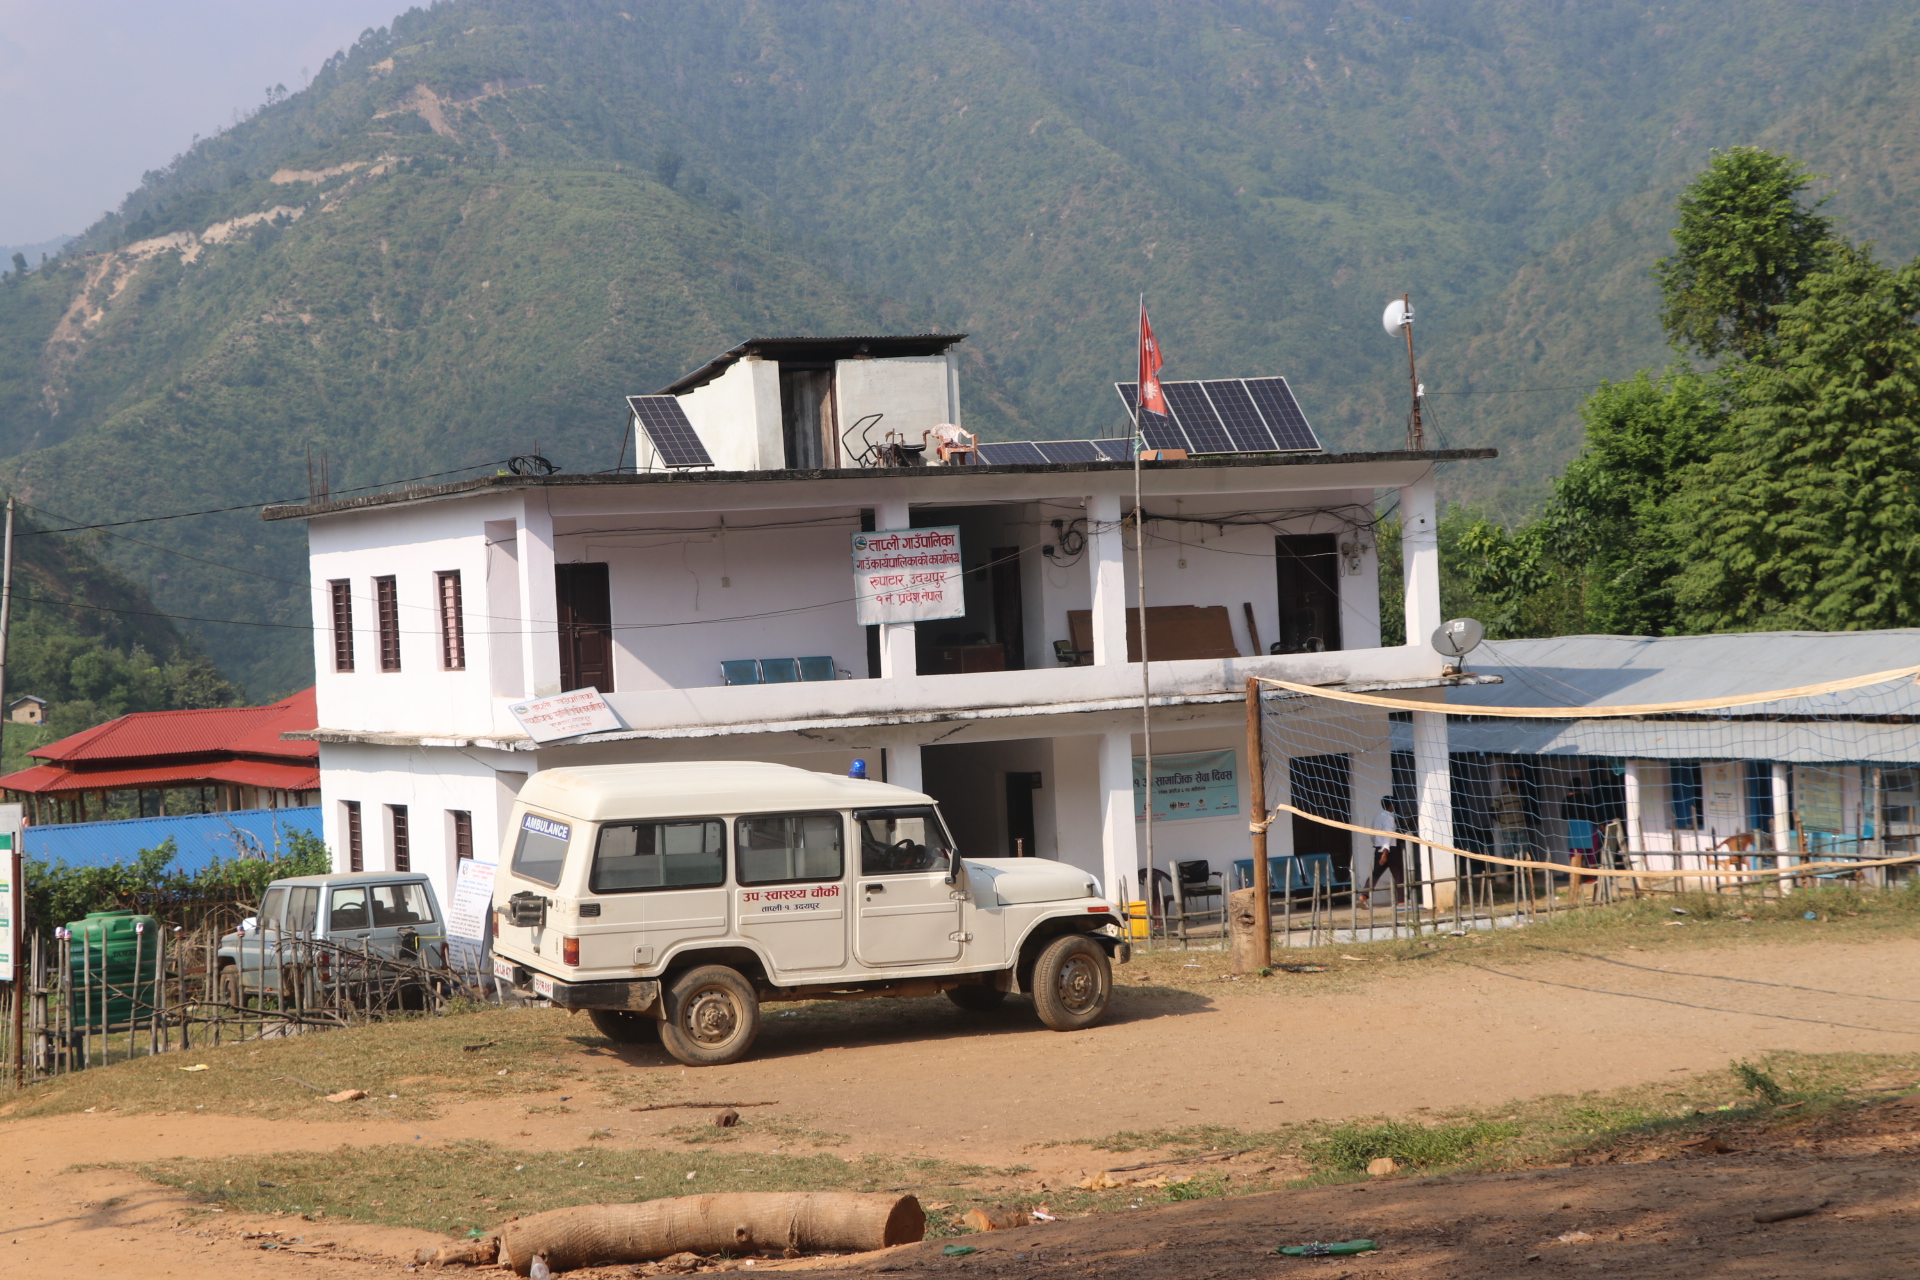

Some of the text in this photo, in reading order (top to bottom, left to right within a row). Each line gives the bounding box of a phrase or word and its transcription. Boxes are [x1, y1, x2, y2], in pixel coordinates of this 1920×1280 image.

[868, 531, 955, 552] ताप्ली गाउँपालिका
[856, 556, 871, 570] गाउँ
[928, 549, 960, 566] कार्यालय
[909, 571, 948, 588] उदयपुर
[921, 588, 943, 602] नेपाल
[1155, 772, 1193, 787] सामाजिक
[1194, 770, 1210, 783] सेवा
[1211, 769, 1233, 781] दिवस
[524, 816, 569, 839] AMBULANCE
[810, 885, 840, 898] चौकी
[793, 902, 821, 911] उदयपुर
